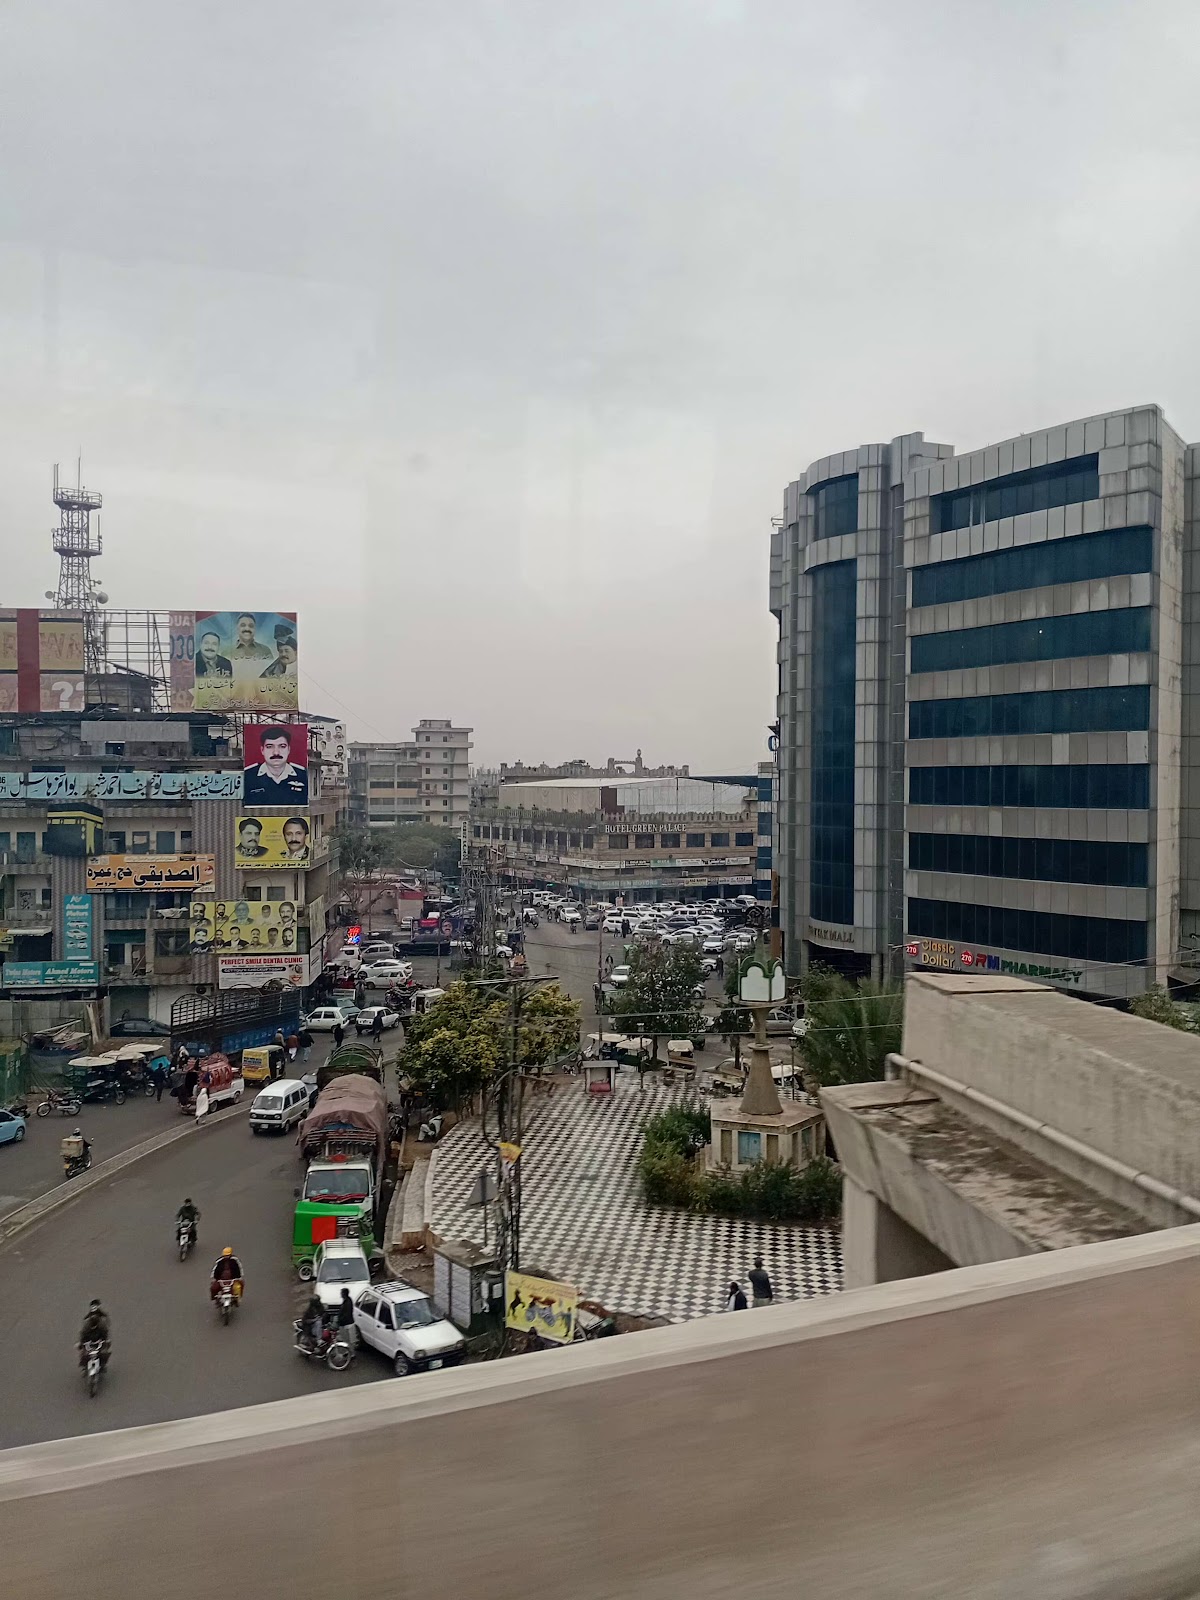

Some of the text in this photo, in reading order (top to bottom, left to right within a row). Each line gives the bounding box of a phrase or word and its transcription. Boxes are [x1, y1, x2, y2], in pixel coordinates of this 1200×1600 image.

[198, 680, 234, 690] کاشف خان
[260, 683, 274, 693] خان
[82, 774, 107, 797] شہید
[101, 775, 121, 796] احمد
[605, 824, 687, 833] HOTEL GREEN PALACE
[88, 866, 112, 880] عمرہ
[117, 866, 132, 879] حج
[830, 930, 854, 944] MALL
[906, 946, 916, 954] 270
[922, 939, 956, 954] Classic
[922, 952, 956, 968] Dollar
[961, 954, 972, 962] 270
[1000, 960, 1083, 983] PHARMACY
